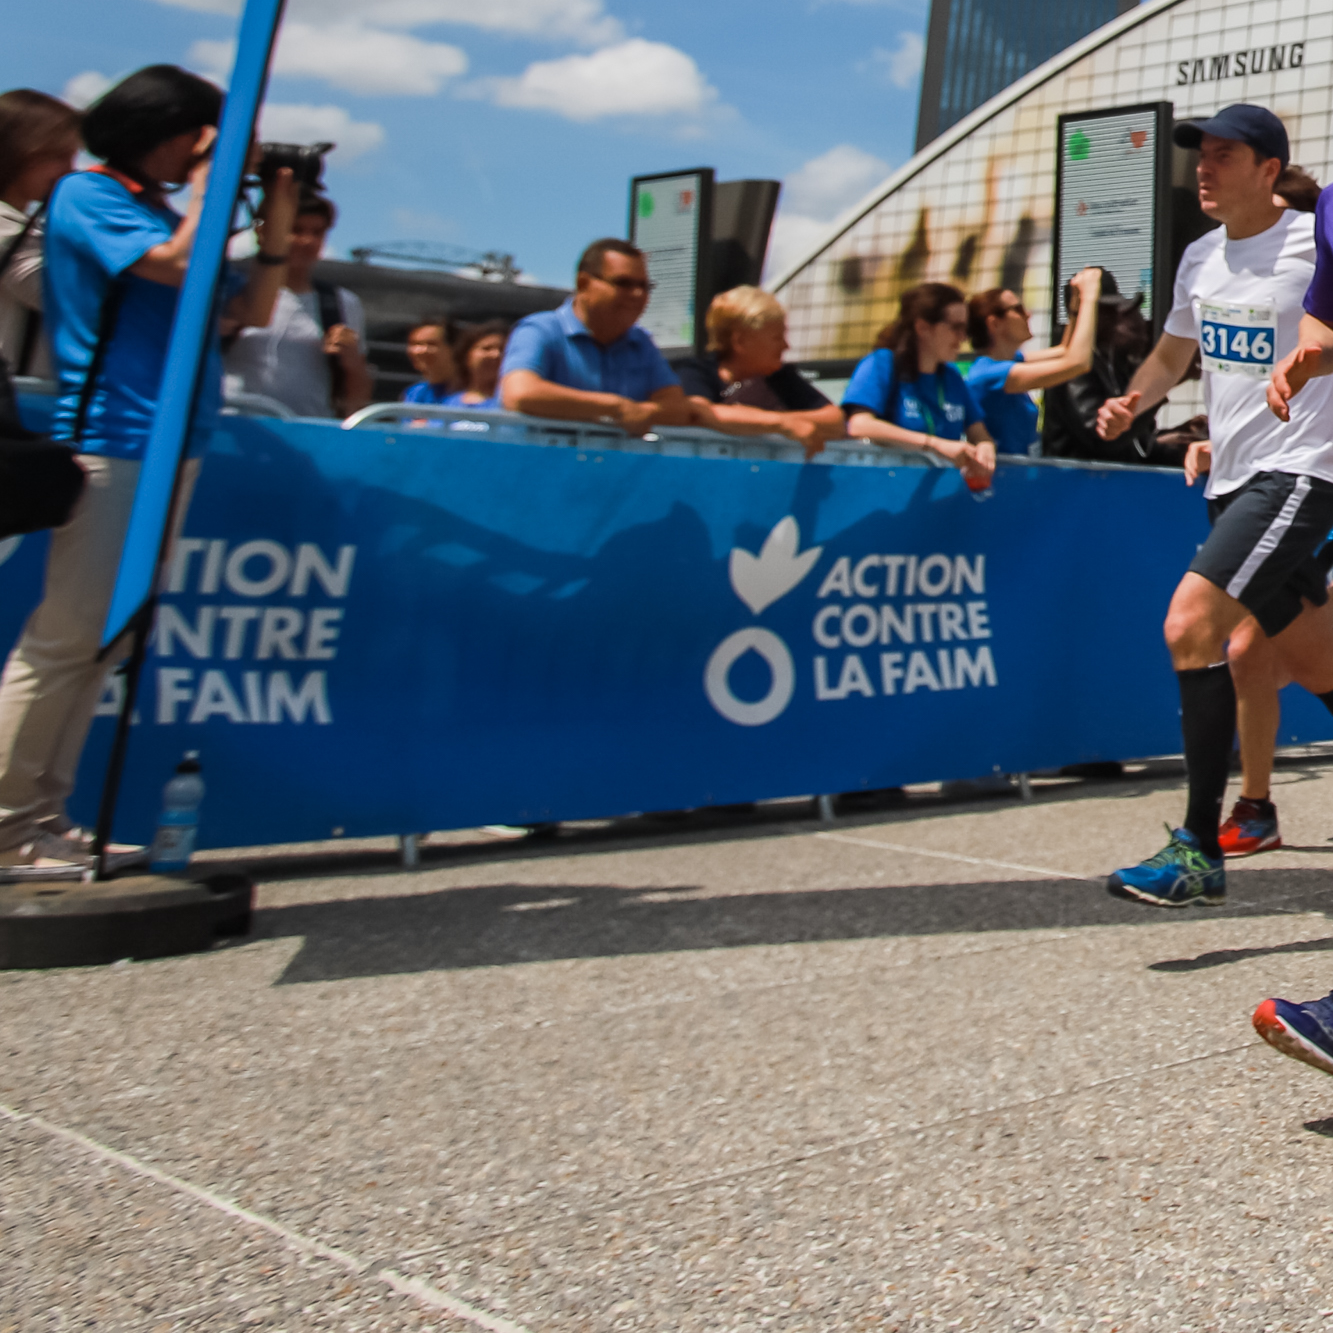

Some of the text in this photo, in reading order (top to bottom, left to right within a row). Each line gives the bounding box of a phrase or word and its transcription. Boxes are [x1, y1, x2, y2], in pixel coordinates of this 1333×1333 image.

[1176, 41, 1305, 87] SAMSUNG
[1202, 324, 1273, 361] 3146
[163, 537, 357, 599] TION
[816, 553, 986, 599] ACTION
[154, 604, 344, 661] NTRE
[812, 601, 992, 649] CONTRE
[153, 666, 333, 725] FAIM
[813, 645, 998, 701] LA FAIM
